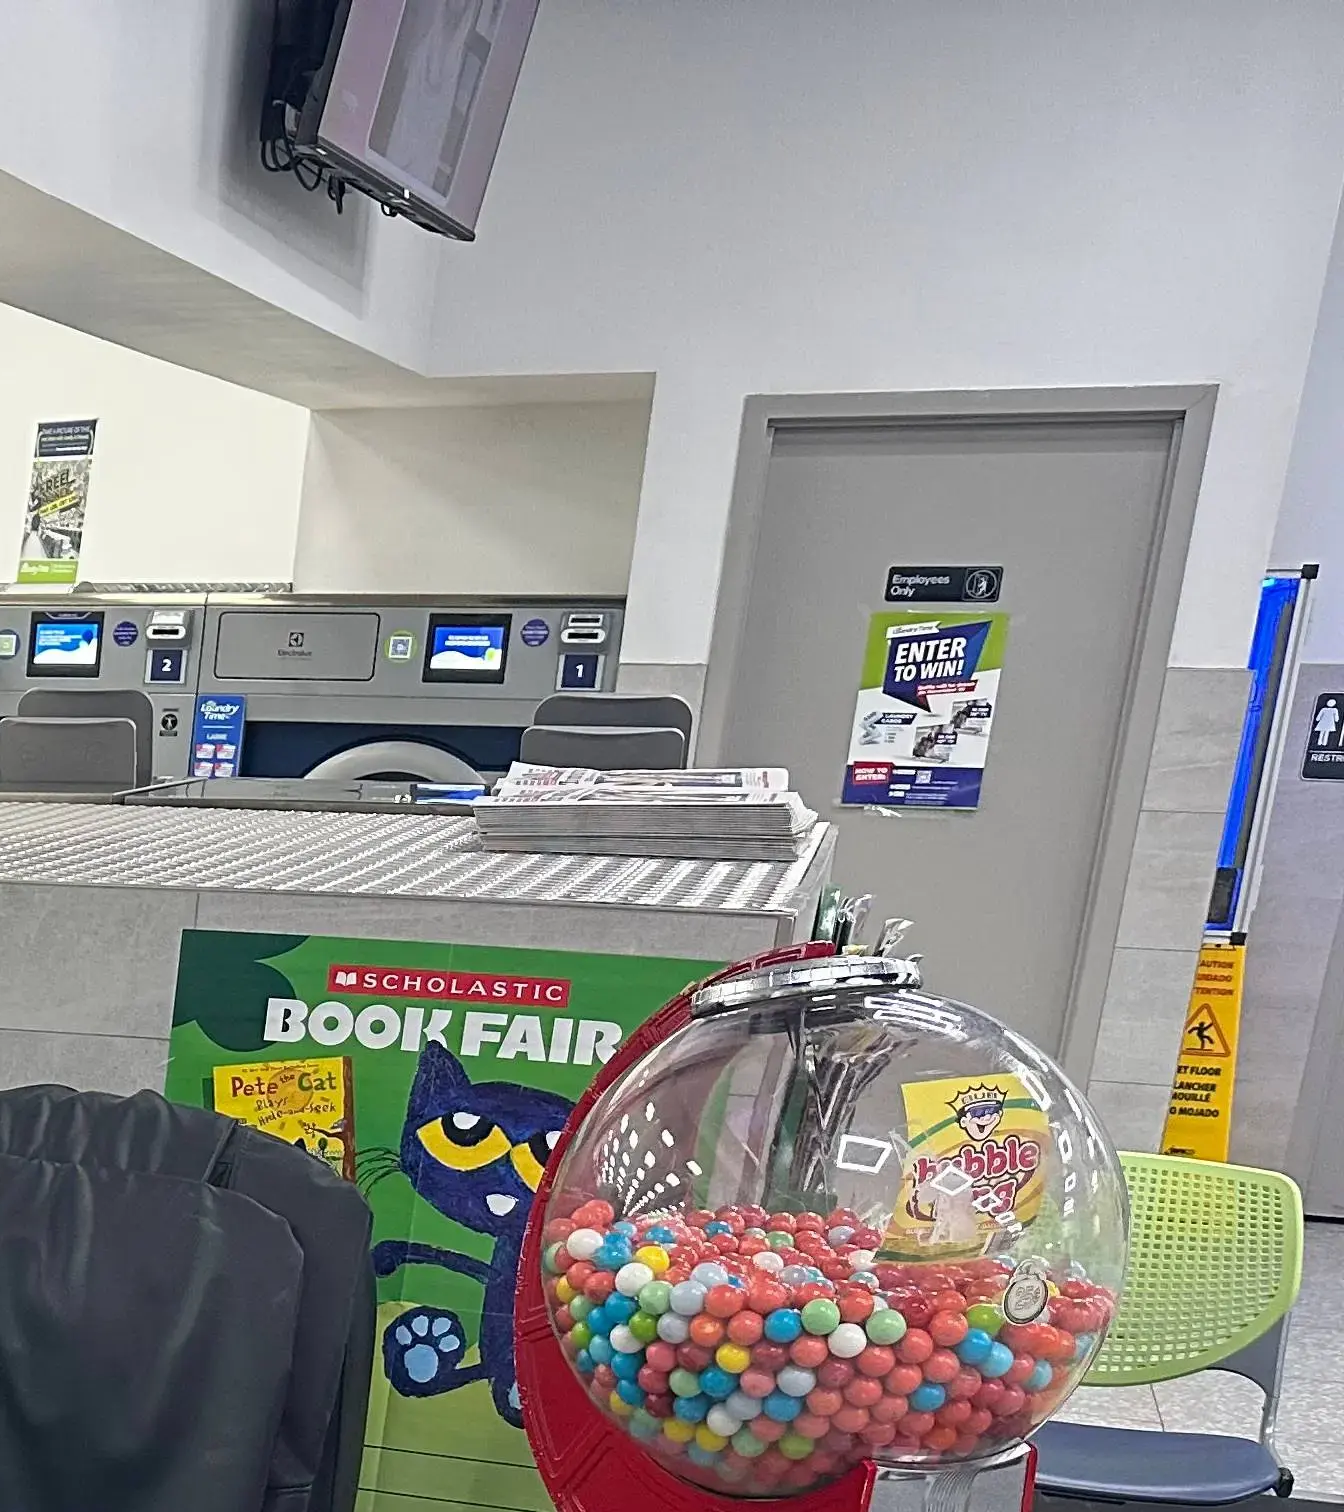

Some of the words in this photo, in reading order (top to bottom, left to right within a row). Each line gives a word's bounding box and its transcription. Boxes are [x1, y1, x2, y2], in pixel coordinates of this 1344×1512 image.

[892, 574, 951, 586] Employees
[890, 586, 916, 597] Only
[894, 637, 967, 665] ENTER
[162, 658, 172, 672] 2
[575, 664, 584, 678] 1
[894, 664, 917, 682] TO
[920, 659, 965, 680] WIN!
[362, 972, 564, 1002] SCHOLASTIC
[263, 997, 453, 1053] BOOK
[460, 1010, 624, 1066] FAIR
[1190, 1066, 1222, 1076] FLOOR
[231, 1076, 278, 1098] Pete
[279, 1073, 296, 1084] the
[297, 1071, 337, 1092] Cat
